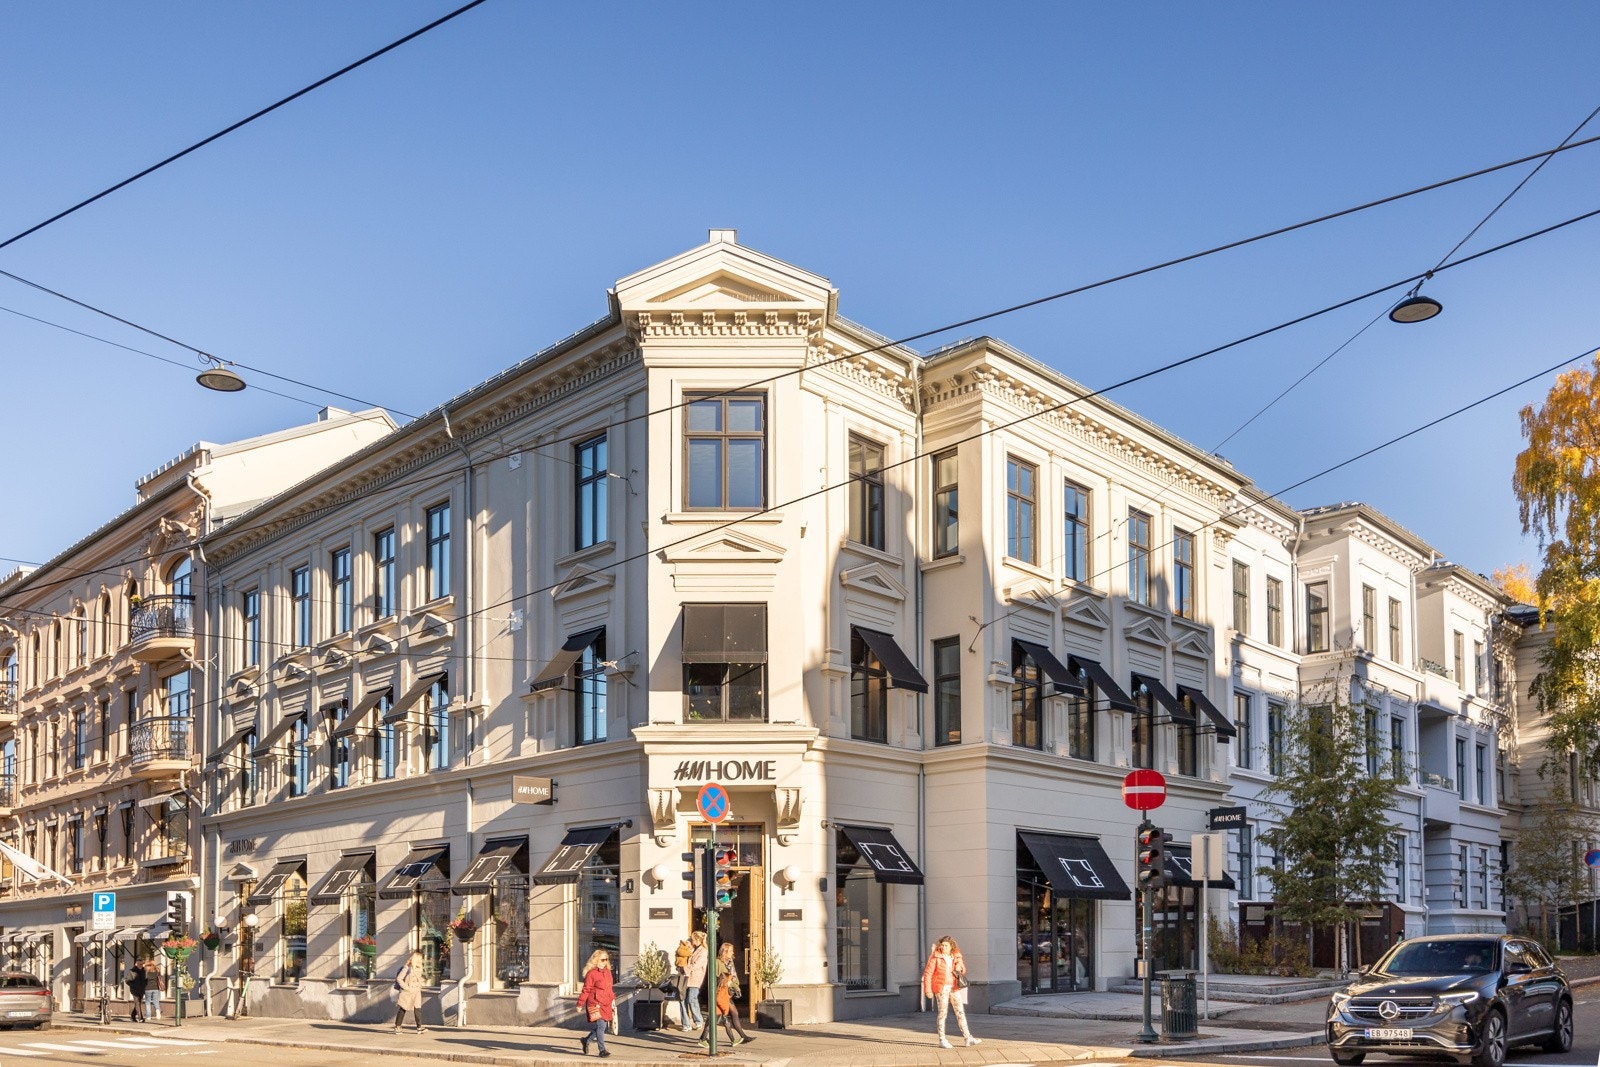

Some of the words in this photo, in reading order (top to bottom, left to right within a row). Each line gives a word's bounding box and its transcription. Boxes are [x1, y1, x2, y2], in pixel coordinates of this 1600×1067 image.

[705, 760, 776, 780] HOME
[528, 787, 549, 795] HOME
[98, 895, 110, 910] P
